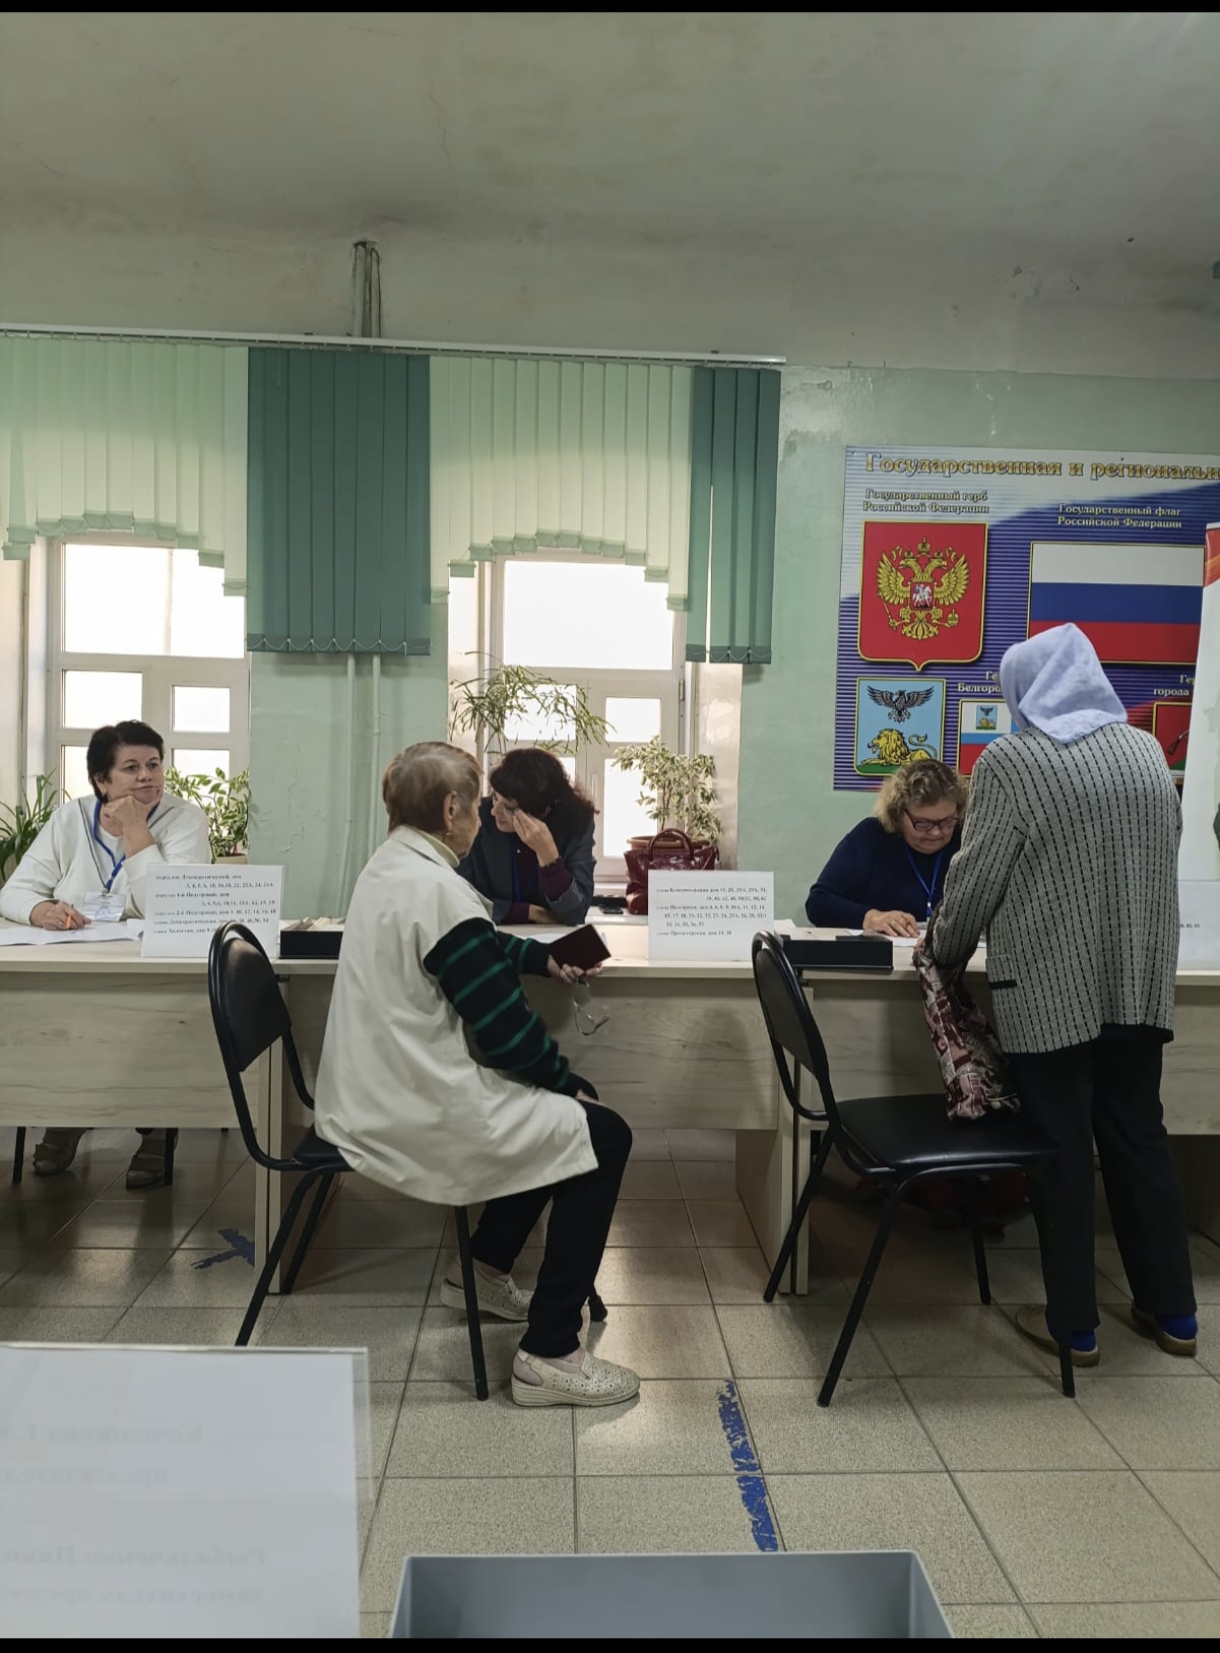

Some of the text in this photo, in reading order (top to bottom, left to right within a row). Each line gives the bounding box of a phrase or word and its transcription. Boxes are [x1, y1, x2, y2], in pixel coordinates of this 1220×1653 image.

[865, 452, 1062, 478] Государственная
[1069, 462, 1084, 476] и
[865, 488, 988, 503] Государственный герб
[863, 501, 990, 514] Российской Федерации
[1058, 503, 1182, 517] Государственный флаг
[1057, 516, 1183, 530] Российской Федерации
[1153, 688, 1190, 697] города
